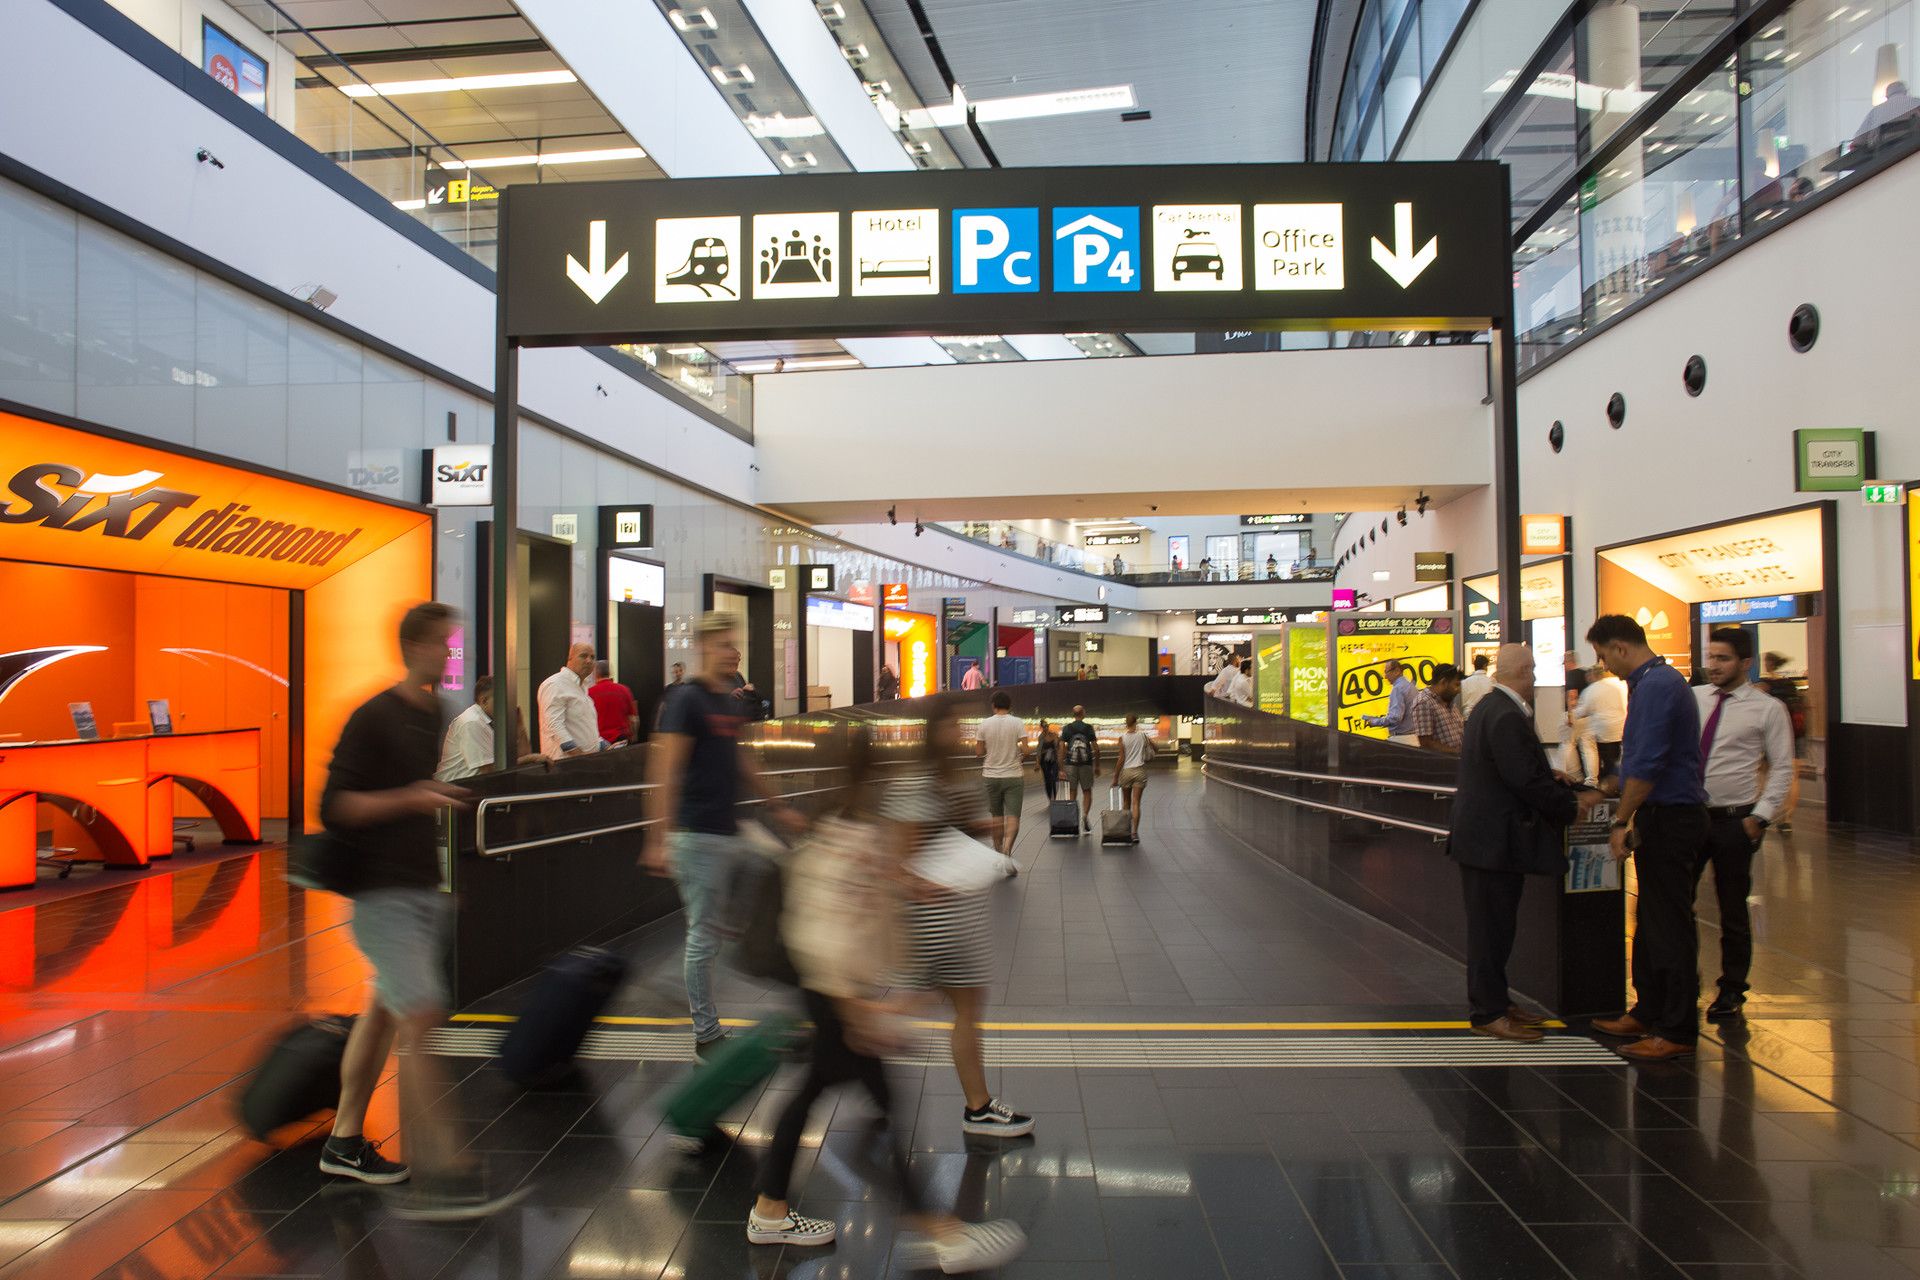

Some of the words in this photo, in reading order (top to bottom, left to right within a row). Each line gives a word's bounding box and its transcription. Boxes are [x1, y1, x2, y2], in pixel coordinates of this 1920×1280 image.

[869, 215, 921, 232] Hotel
[1158, 211, 1183, 223] Car
[1187, 210, 1236, 223] Rental
[1262, 228, 1335, 253] Office
[1073, 234, 1135, 285] P4
[1273, 257, 1327, 276] Park
[1823, 450, 1844, 458] CITY
[1811, 460, 1855, 469] TRANSFER
[172, 503, 363, 567] diamond
